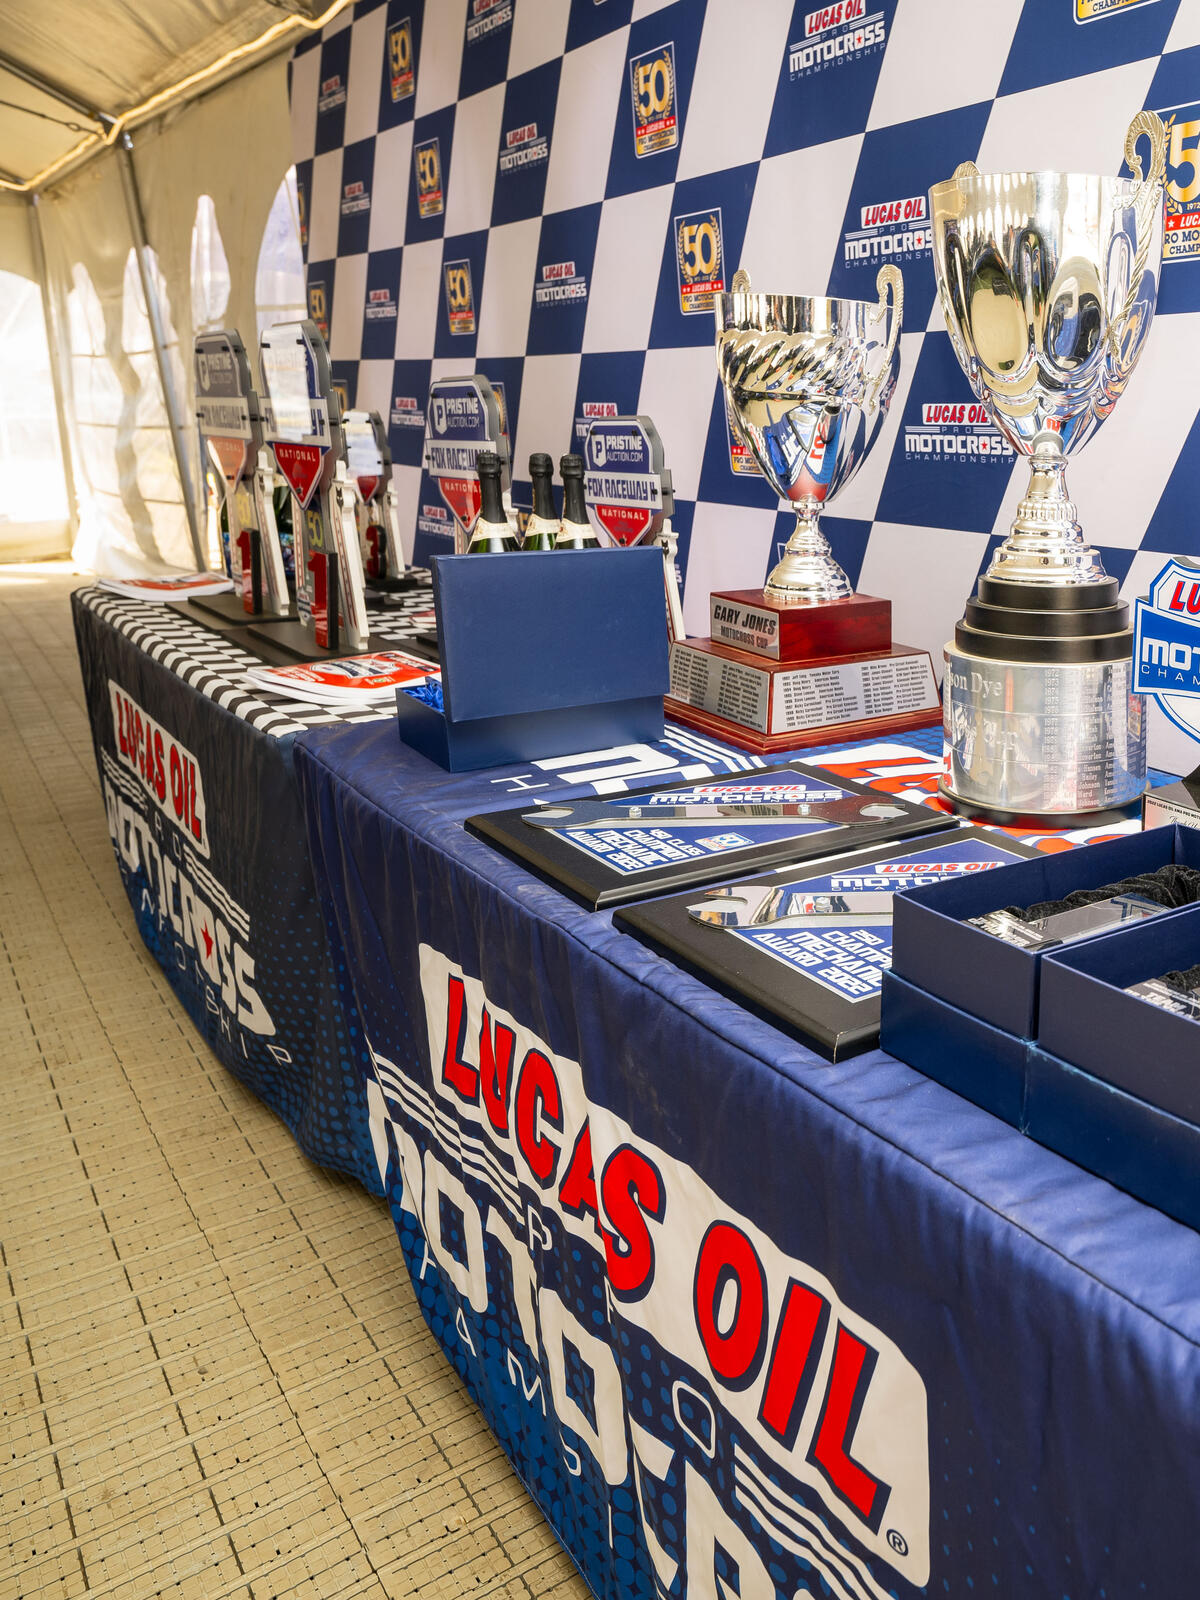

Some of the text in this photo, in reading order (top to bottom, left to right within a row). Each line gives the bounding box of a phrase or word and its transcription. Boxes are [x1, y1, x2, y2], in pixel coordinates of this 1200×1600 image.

[808, 0, 864, 35] LUCAS OIL
[821, 24, 848, 41] PRO
[789, 20, 885, 73] MOTOCROSS
[790, 42, 886, 81] CHAMPIONSHIP
[639, 59, 670, 117] 50
[864, 198, 924, 226] LUCAS OIL
[1187, 201, 1200, 210] 1972
[879, 223, 908, 236] PRO
[683, 222, 717, 277] 50
[845, 230, 933, 260] MOTOCROS
[845, 251, 932, 269] CHAMPIONSH
[536, 283, 587, 302] MOTOCROSS
[446, 398, 479, 415] PRISTINE
[585, 405, 604, 416] LUCAS
[926, 405, 988, 423] LUCAS OIL
[942, 426, 972, 434] PRO
[606, 435, 643, 450] PRISTINE
[905, 434, 1014, 455] MOTOCROSS
[279, 449, 317, 462] NATIONAL
[431, 447, 447, 469] FOX
[606, 451, 644, 463] AUCTION.COM
[905, 453, 1015, 464] CHAMPIONSHIP
[444, 482, 482, 493] NATIONA
[587, 477, 604, 498] FOX
[605, 479, 649, 501] RACEWAY
[601, 508, 645, 521] NATIONAL
[306, 510, 324, 548] 50
[714, 604, 777, 637] GARY JONES
[720, 625, 755, 647] MOTOCROSS
[970, 672, 1002, 698] Dye
[115, 689, 202, 844] LUCAS OIL
[650, 792, 843, 803] MOTOCROSS
[699, 785, 801, 794] LUCAS OIL
[882, 863, 960, 873] LUCAS
[849, 929, 885, 945] 250
[752, 933, 873, 996] AWARD 2022
[441, 970, 666, 1303] LUCAS
[693, 1219, 893, 1535] OIL
